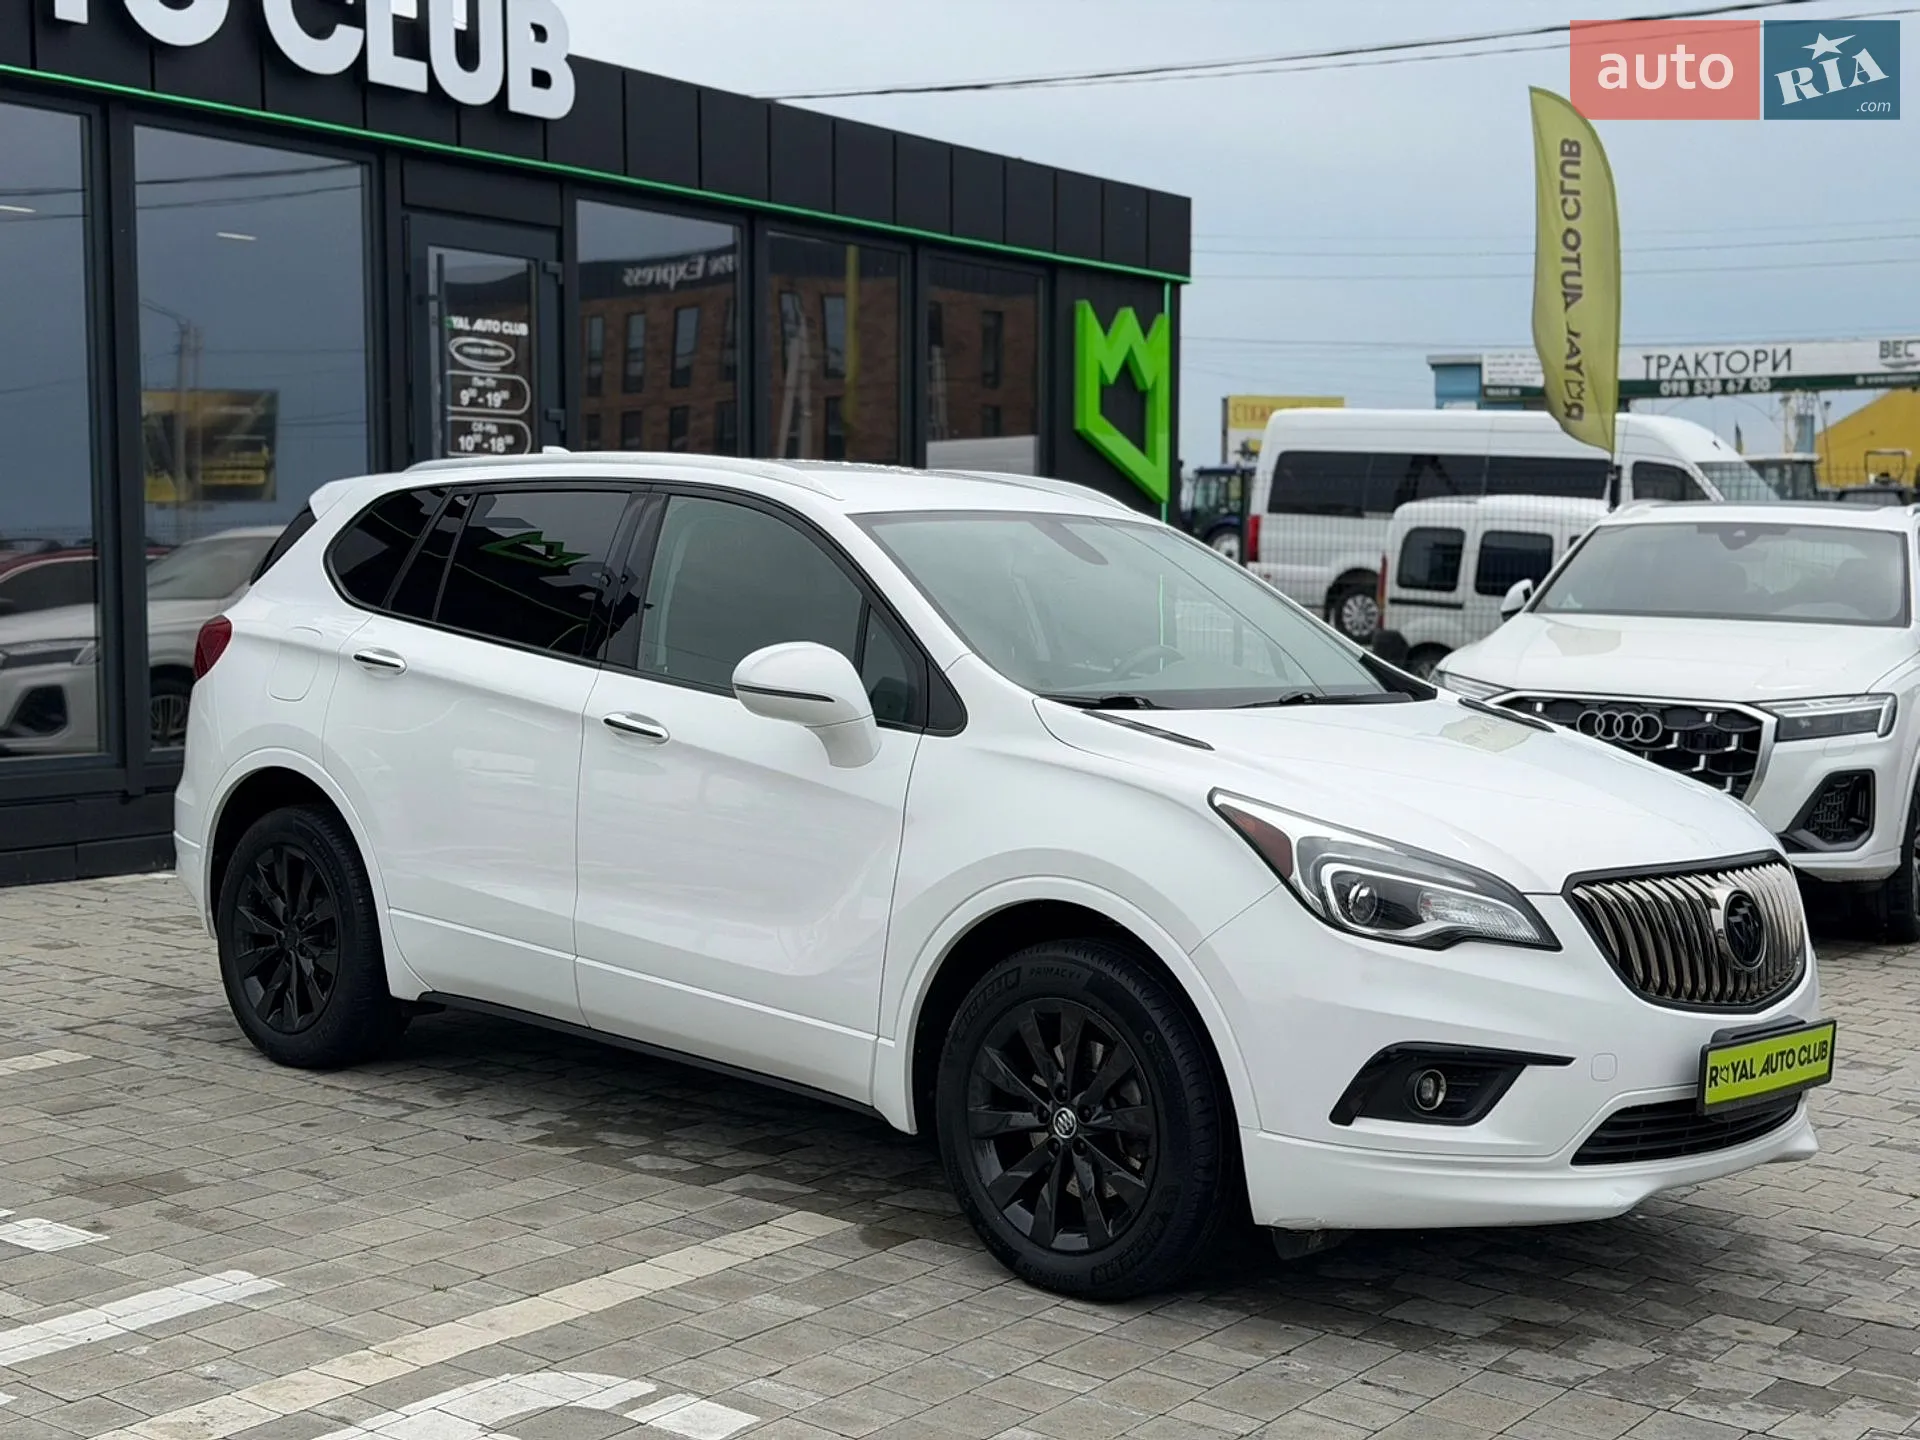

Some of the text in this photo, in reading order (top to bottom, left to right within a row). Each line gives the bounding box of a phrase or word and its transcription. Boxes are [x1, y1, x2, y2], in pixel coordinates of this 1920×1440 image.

[263, 0, 577, 120] CLUB
[472, 318, 500, 333] AUTO
[501, 320, 528, 336] CLUB
[1879, 340, 1920, 359] ВЕС
[1642, 348, 1792, 380] ТРАКТОРИ
[1749, 377, 1771, 392] 00
[1759, 1048, 1796, 1077] AUTO
[1797, 1039, 1829, 1067] CLUB
